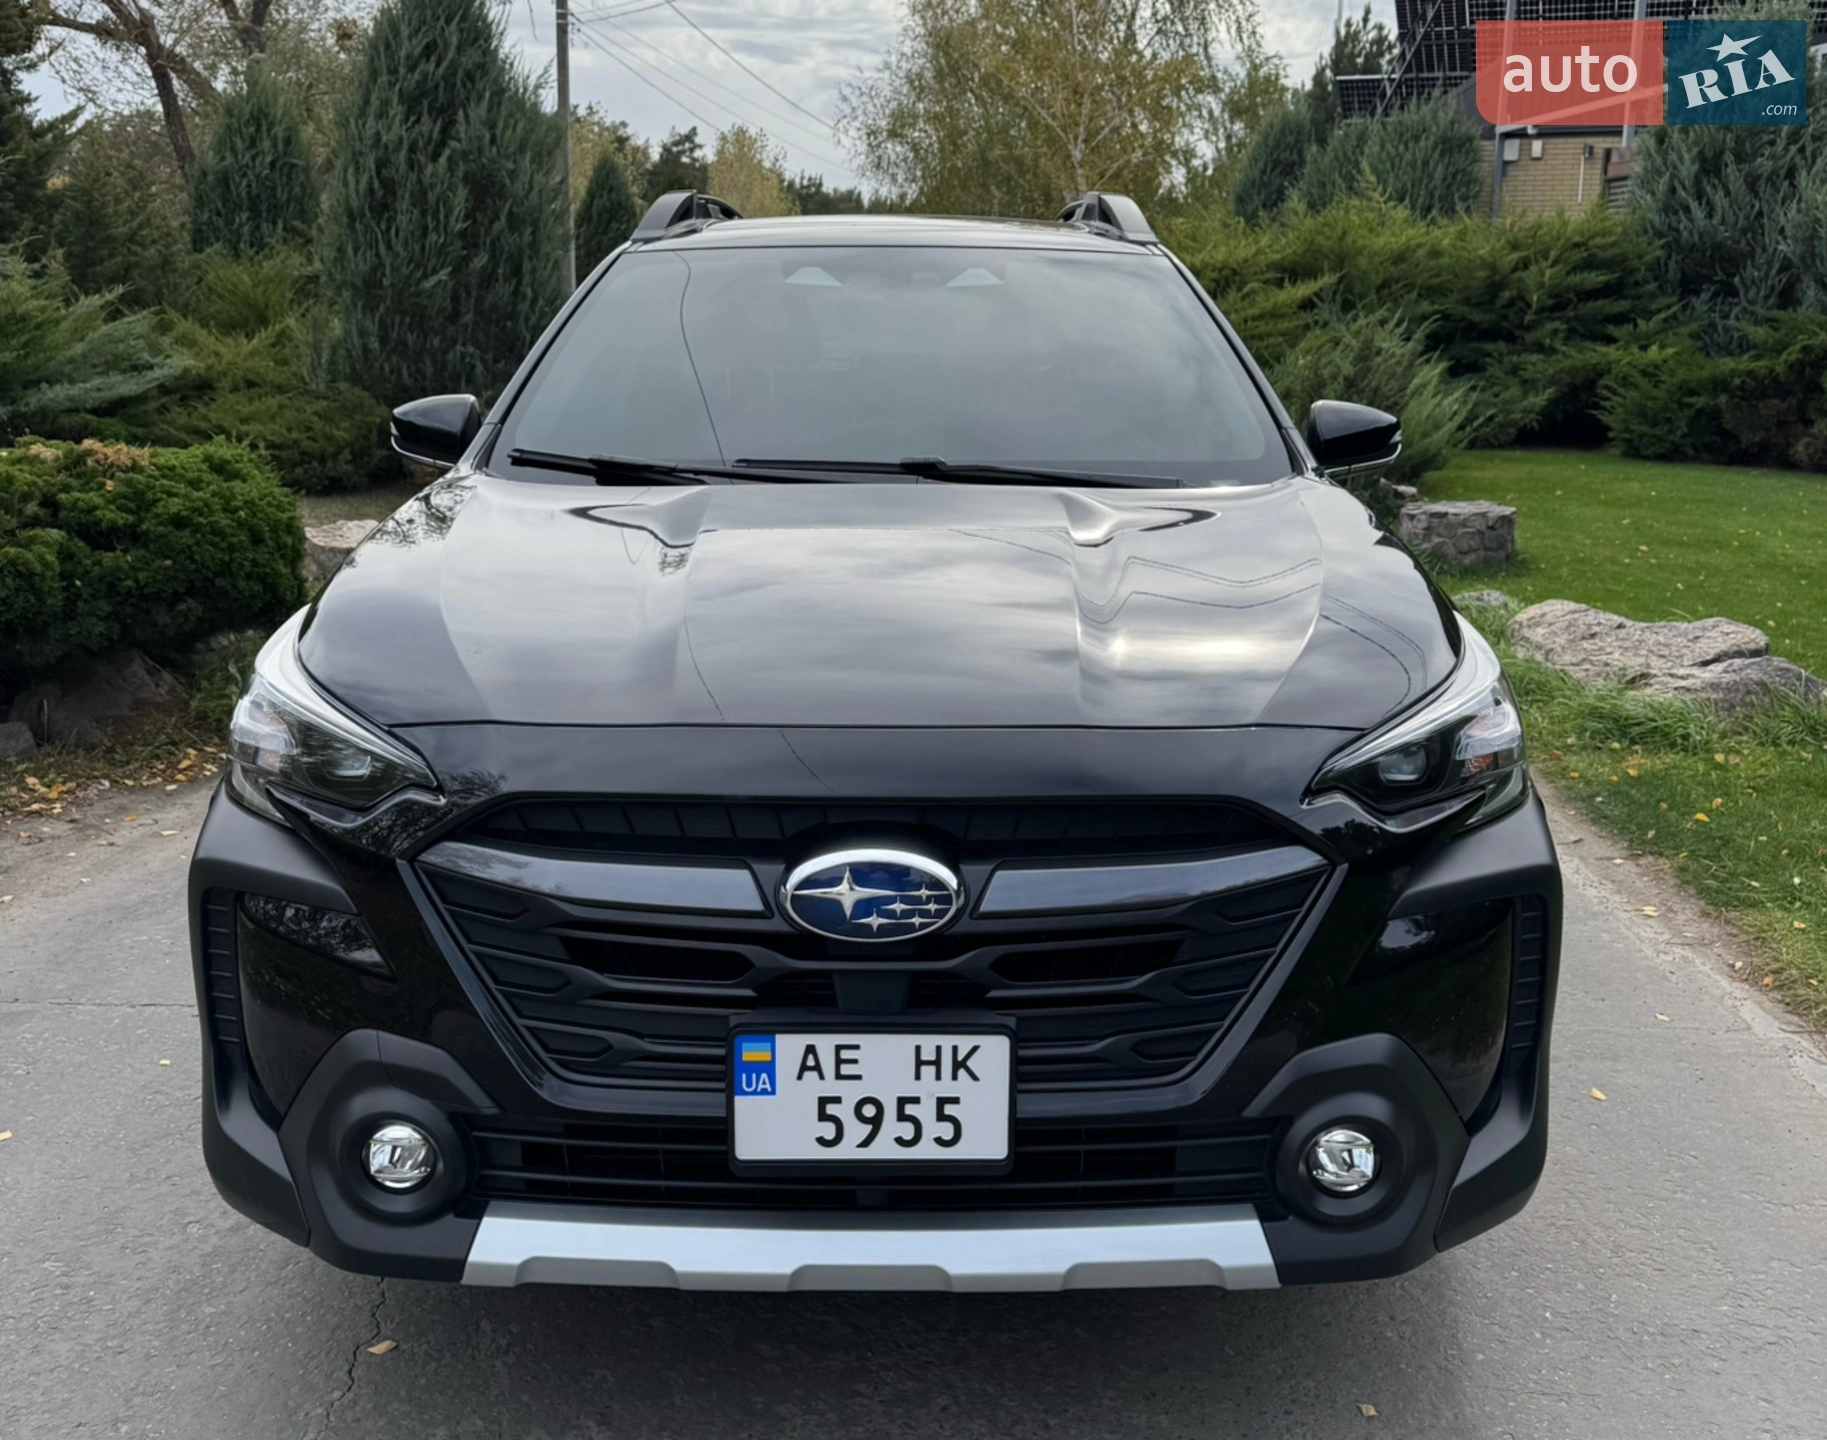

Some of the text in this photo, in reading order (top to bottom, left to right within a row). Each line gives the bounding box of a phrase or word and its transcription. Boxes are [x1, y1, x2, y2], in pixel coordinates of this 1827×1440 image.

[796, 1044, 981, 1082] AE HK
[741, 1072, 772, 1093] UA
[814, 1096, 963, 1149] 5955
